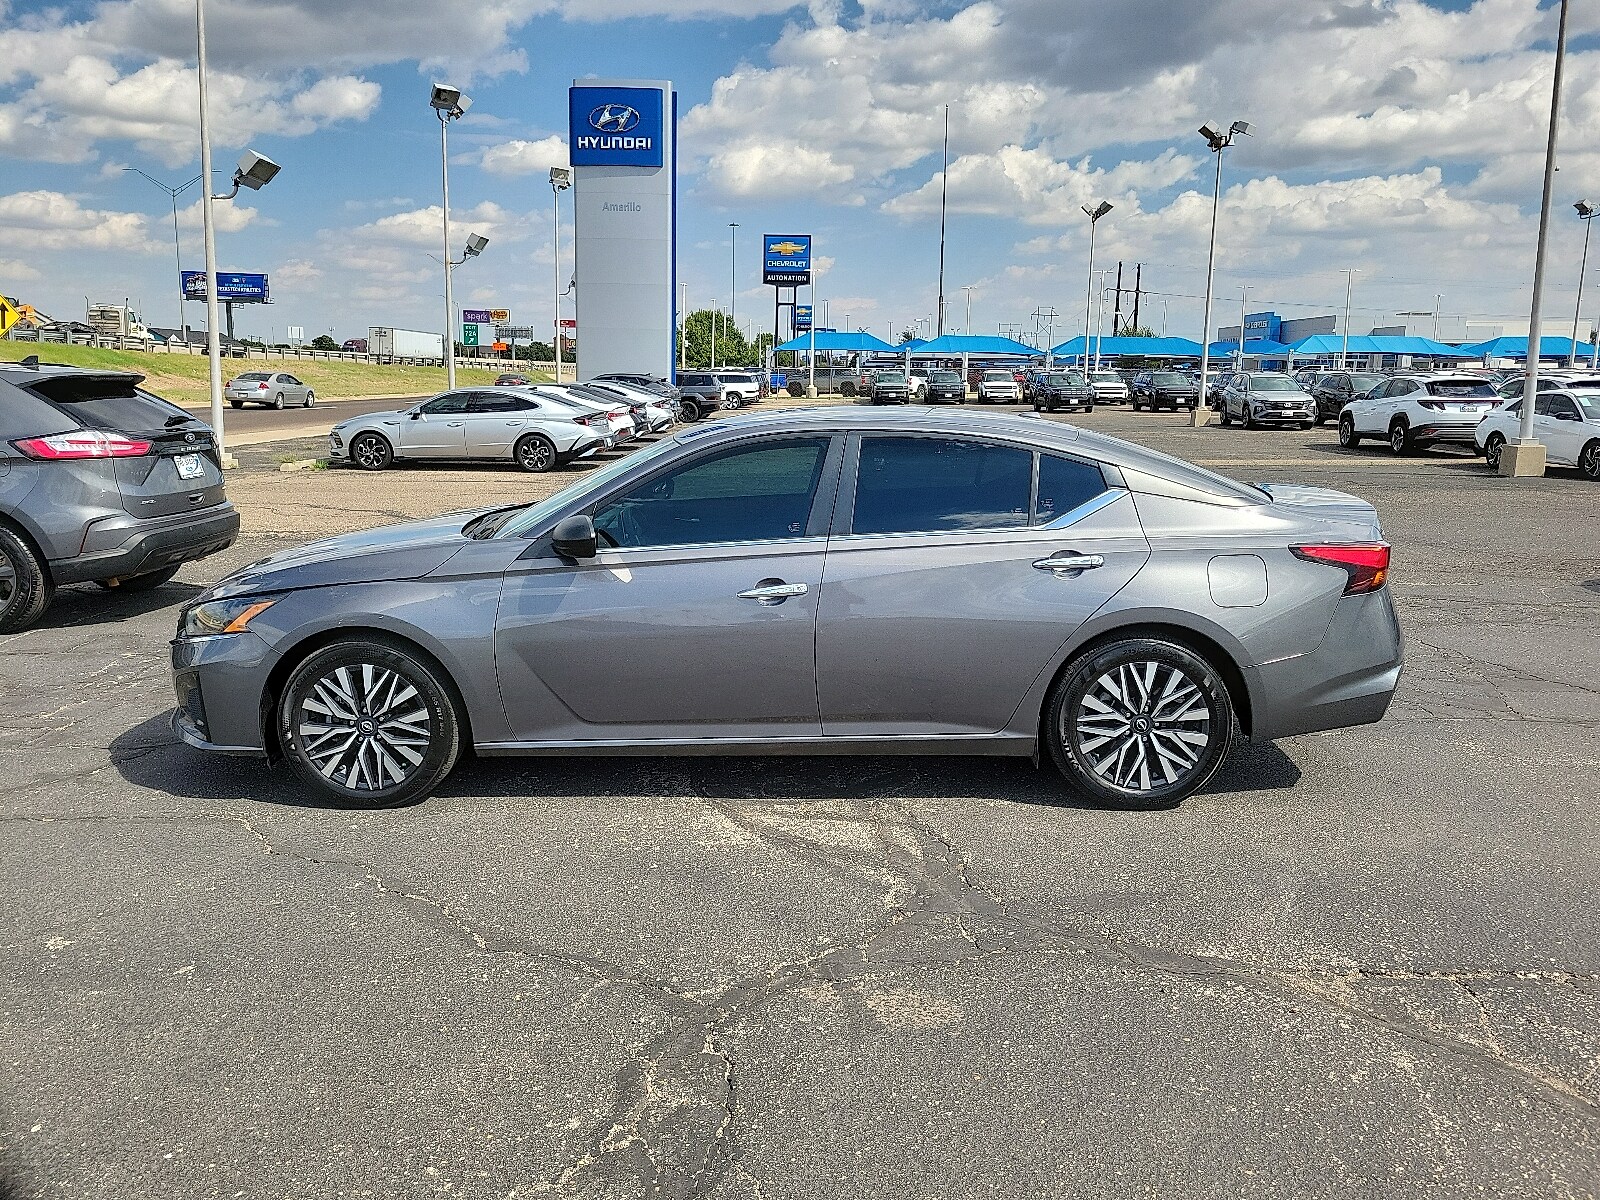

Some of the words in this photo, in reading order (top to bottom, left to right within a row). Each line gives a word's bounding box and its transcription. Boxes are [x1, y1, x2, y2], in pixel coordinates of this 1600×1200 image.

[577, 136, 652, 150] HYUNDAI
[602, 201, 642, 212] Amarillo
[767, 260, 807, 268] CHEVROLET
[766, 274, 807, 282] AUTONATION
